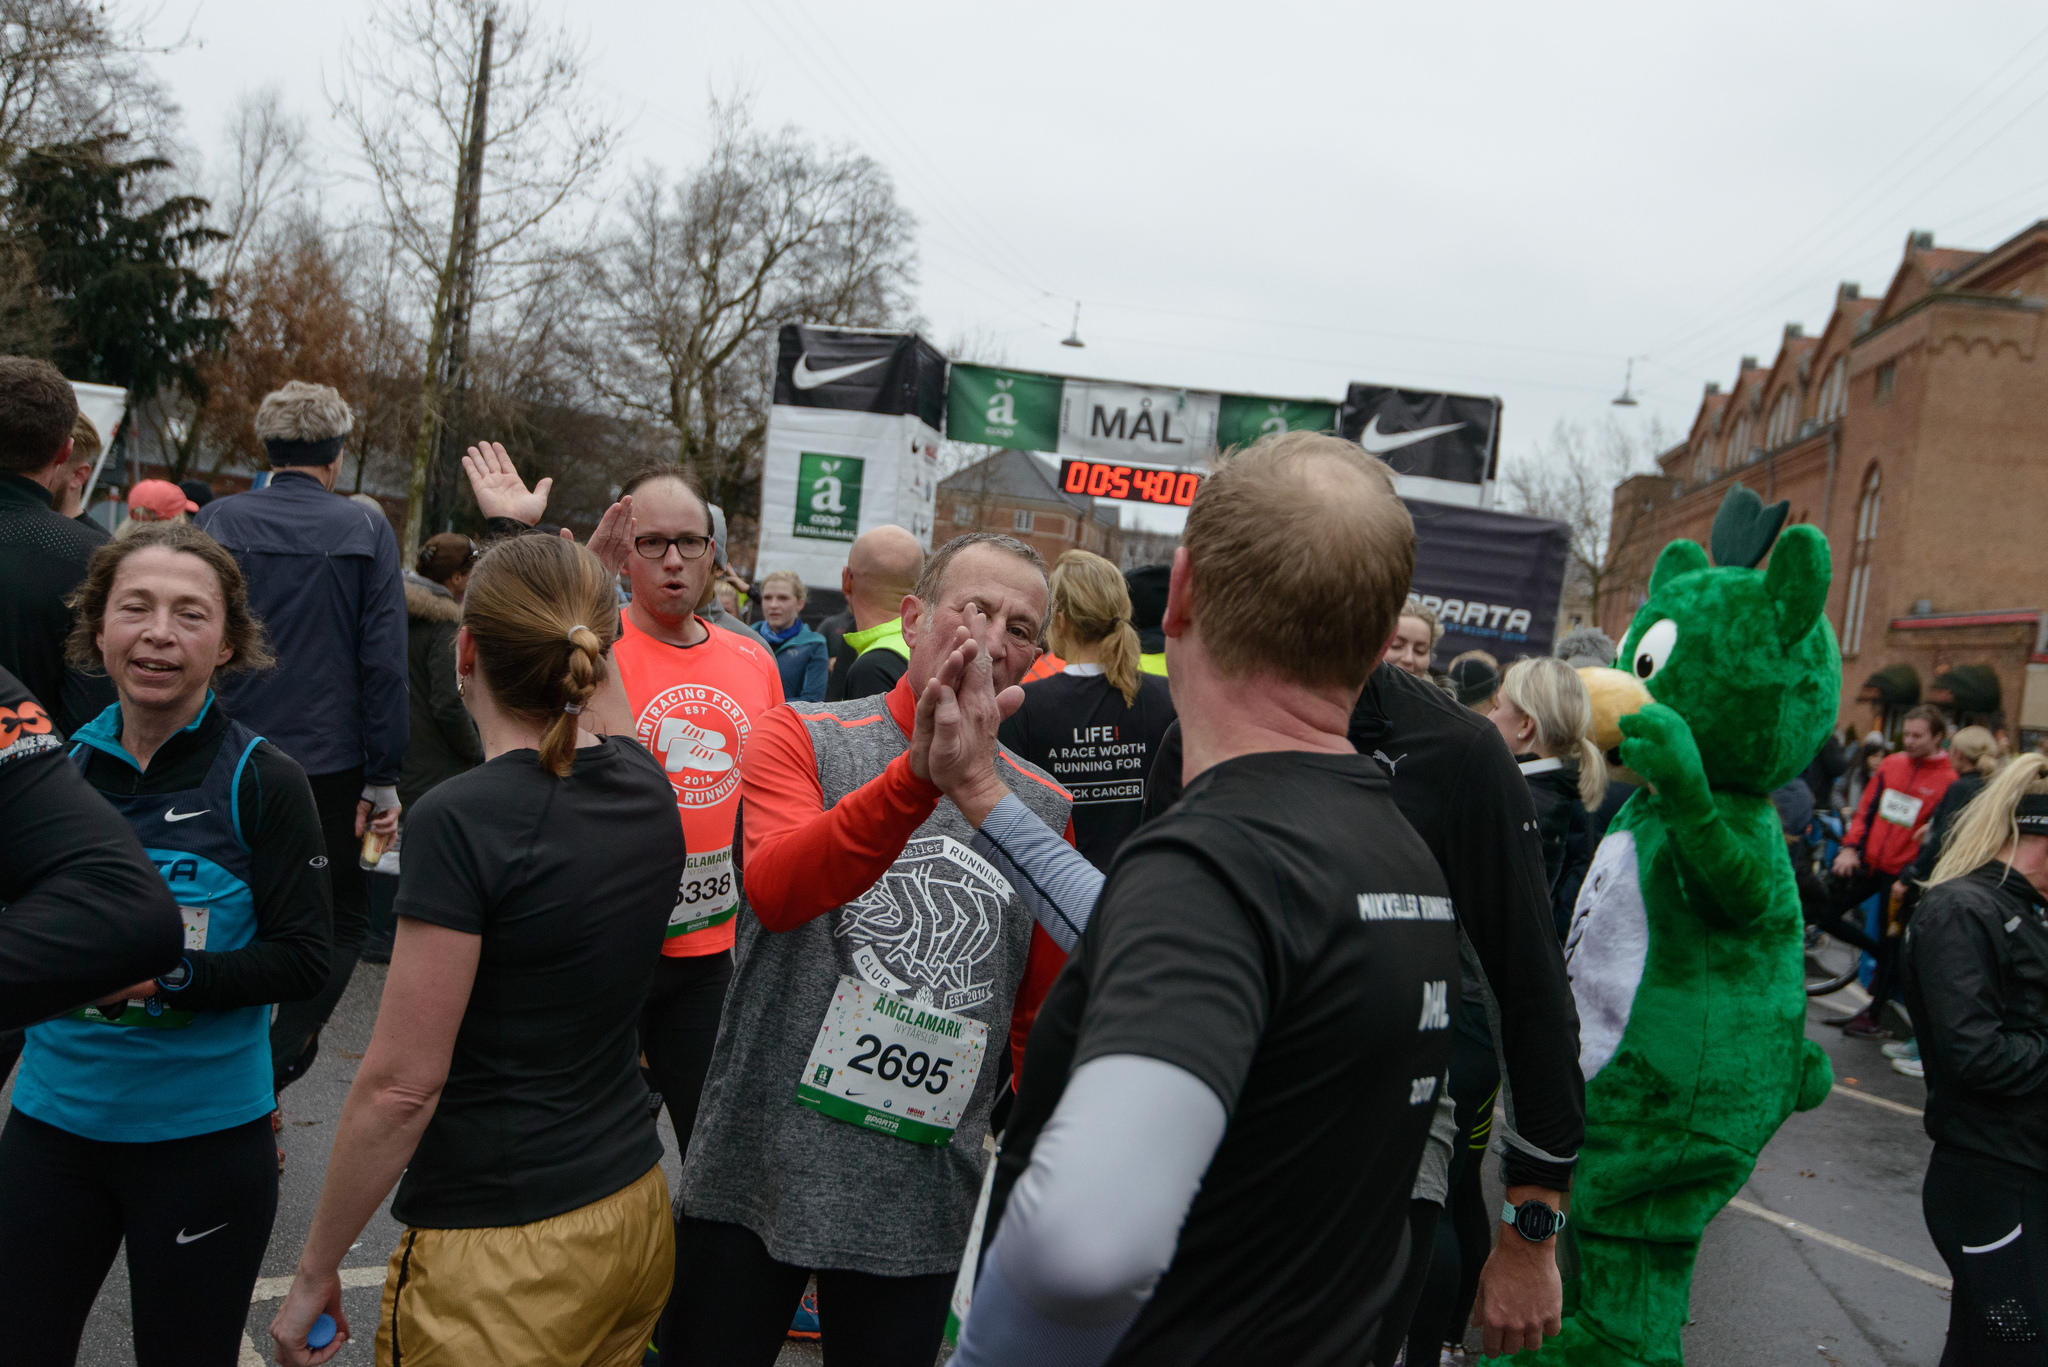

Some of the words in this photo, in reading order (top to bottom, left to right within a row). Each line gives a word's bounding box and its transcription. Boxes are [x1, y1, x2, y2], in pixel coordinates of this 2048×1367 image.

[1091, 397, 1184, 444] MÅL
[650, 688, 706, 718] RACING
[712, 693, 740, 719] FOR
[685, 706, 708, 715] EST
[1073, 725, 1119, 743] LIFE!
[1048, 748, 1057, 759] A
[1061, 747, 1096, 758] RACE
[1099, 742, 1146, 756] WORTH
[1054, 760, 1112, 773] RUNNING
[1116, 758, 1141, 770] FOR
[683, 775, 713, 785] 2014
[684, 768, 740, 804] RUNNING
[1092, 785, 1140, 798] CANCER
[949, 846, 1004, 890] RUNNING
[860, 954, 891, 988] CLUB
[950, 992, 964, 1008] EST
[967, 989, 986, 1002] 2014
[873, 993, 962, 1039] ÄNGLAMARK
[894, 1022, 939, 1045] NYTÅRSLØB
[847, 1033, 953, 1095] 2695
[864, 1114, 899, 1130] SPARTA
